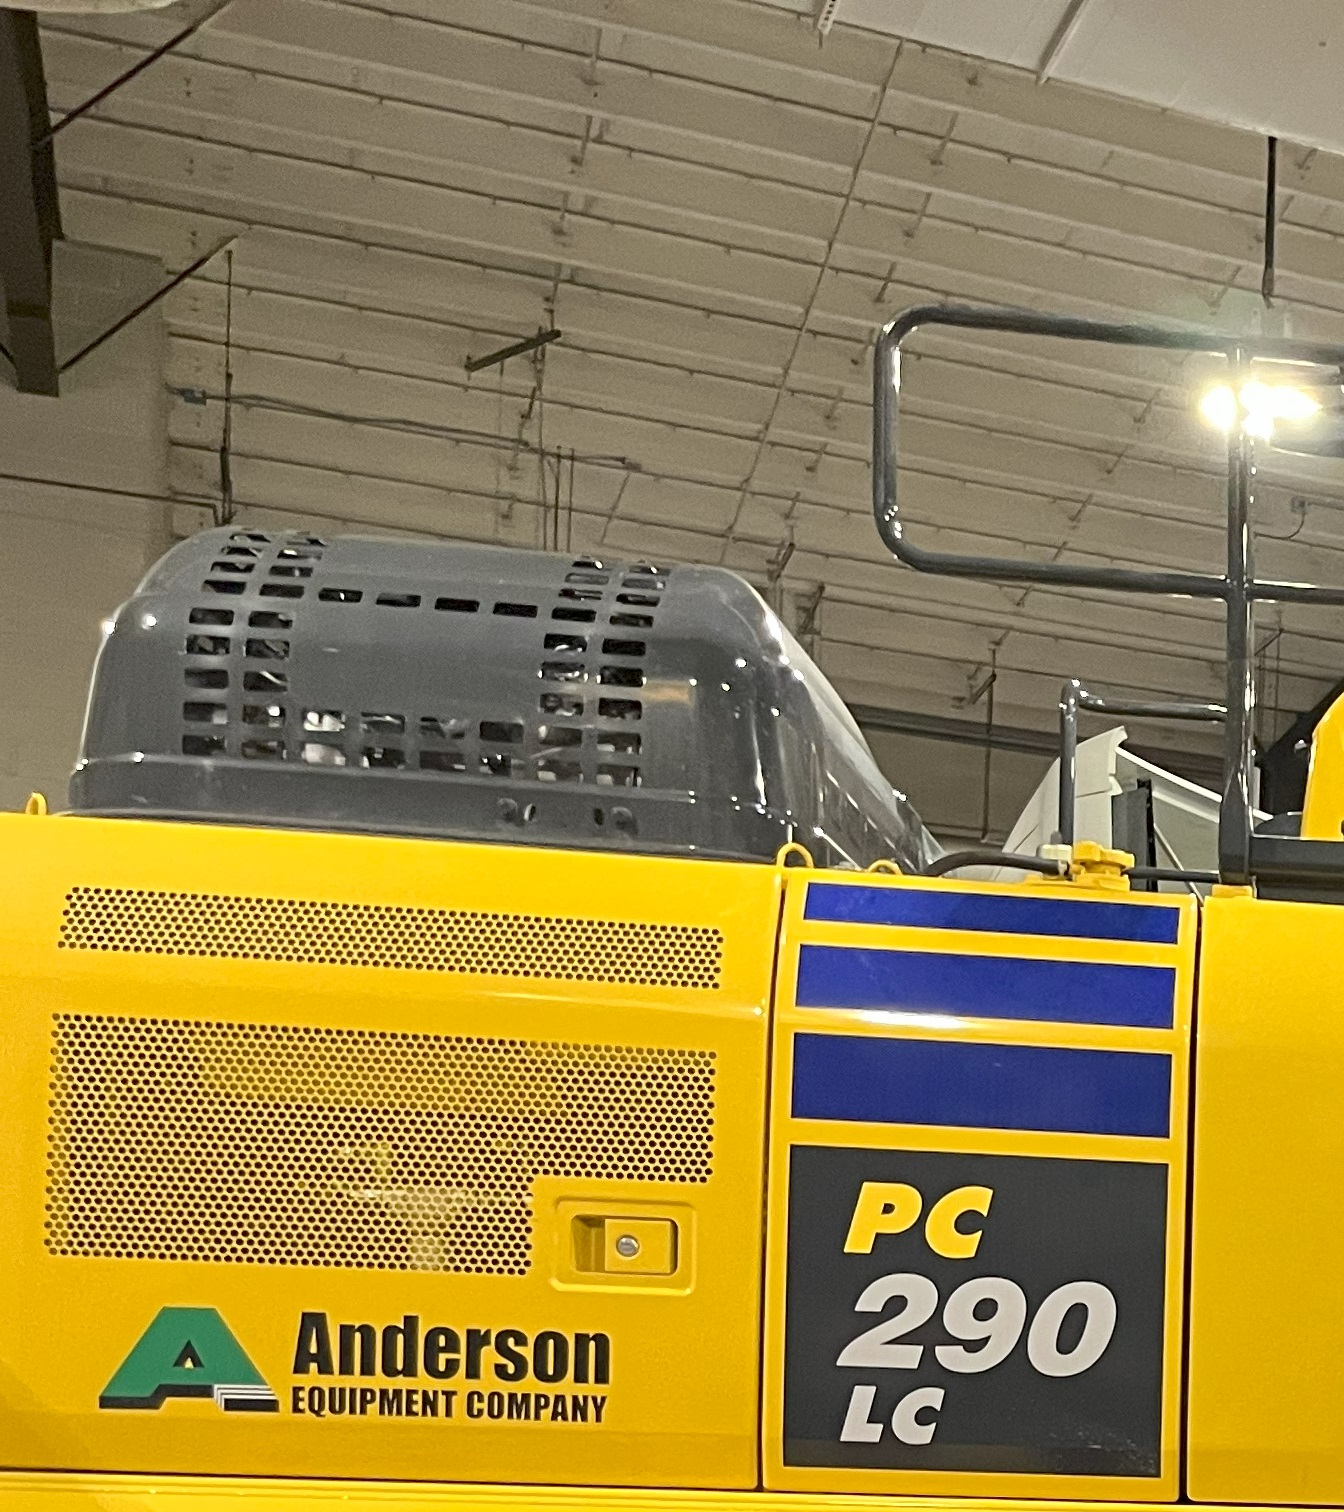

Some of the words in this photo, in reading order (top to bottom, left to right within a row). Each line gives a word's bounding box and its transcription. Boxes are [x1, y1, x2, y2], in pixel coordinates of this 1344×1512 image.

[843, 1181, 994, 1259] PC
[293, 1312, 610, 1385] Anderson
[836, 1272, 1117, 1378] 290
[292, 1386, 459, 1418] EQUIPMENT
[466, 1388, 607, 1424] COMPANY
[840, 1385, 945, 1445] LC
